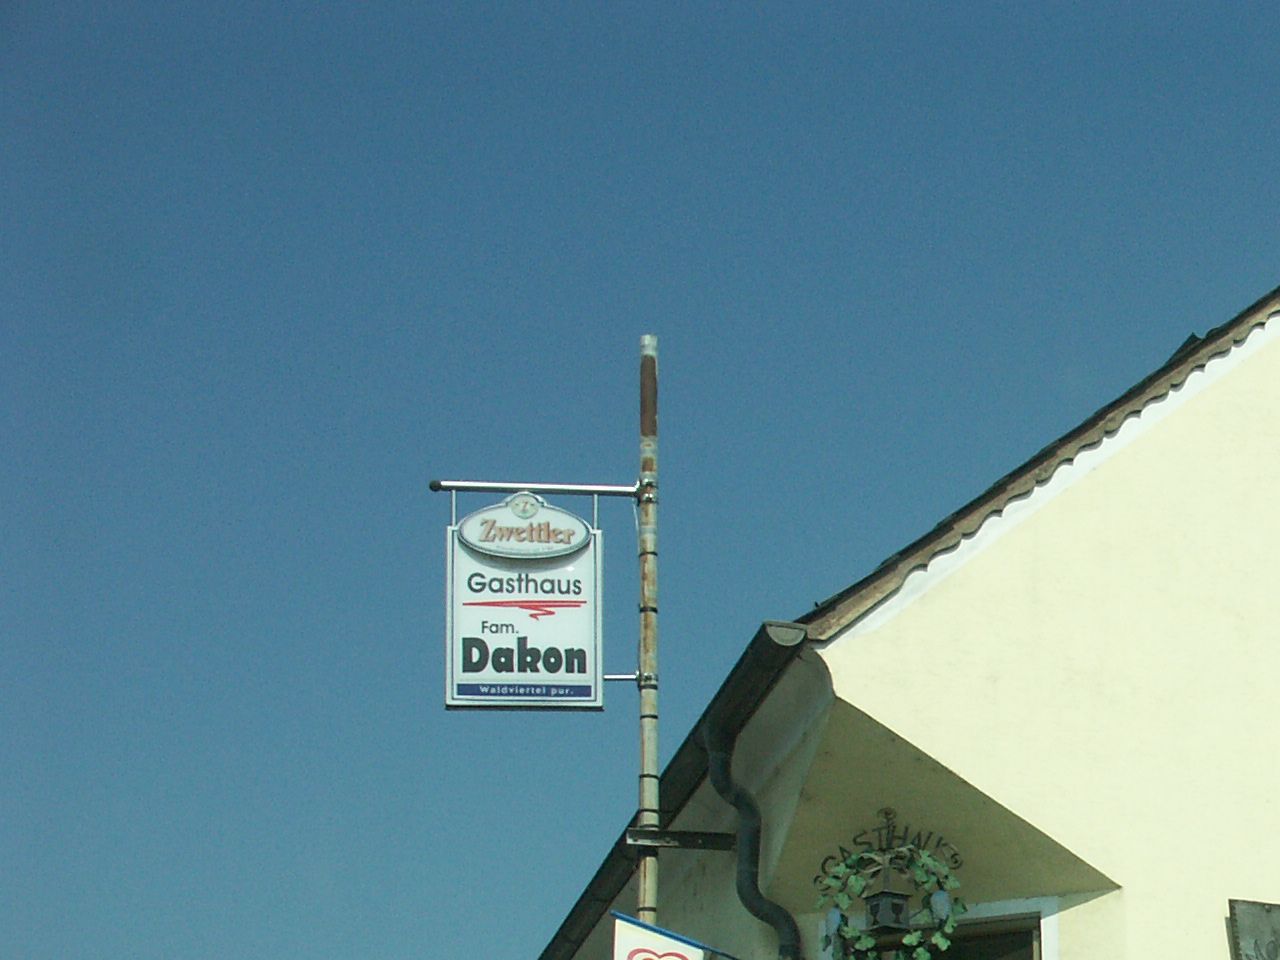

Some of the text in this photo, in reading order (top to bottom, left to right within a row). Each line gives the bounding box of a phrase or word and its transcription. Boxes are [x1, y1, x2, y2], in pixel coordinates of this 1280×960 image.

[477, 518, 576, 545] Zwettler
[467, 572, 582, 595] Gasthaus
[481, 620, 519, 634] Fam.
[461, 636, 587, 674] Dakon
[479, 685, 546, 695] Waldviertel
